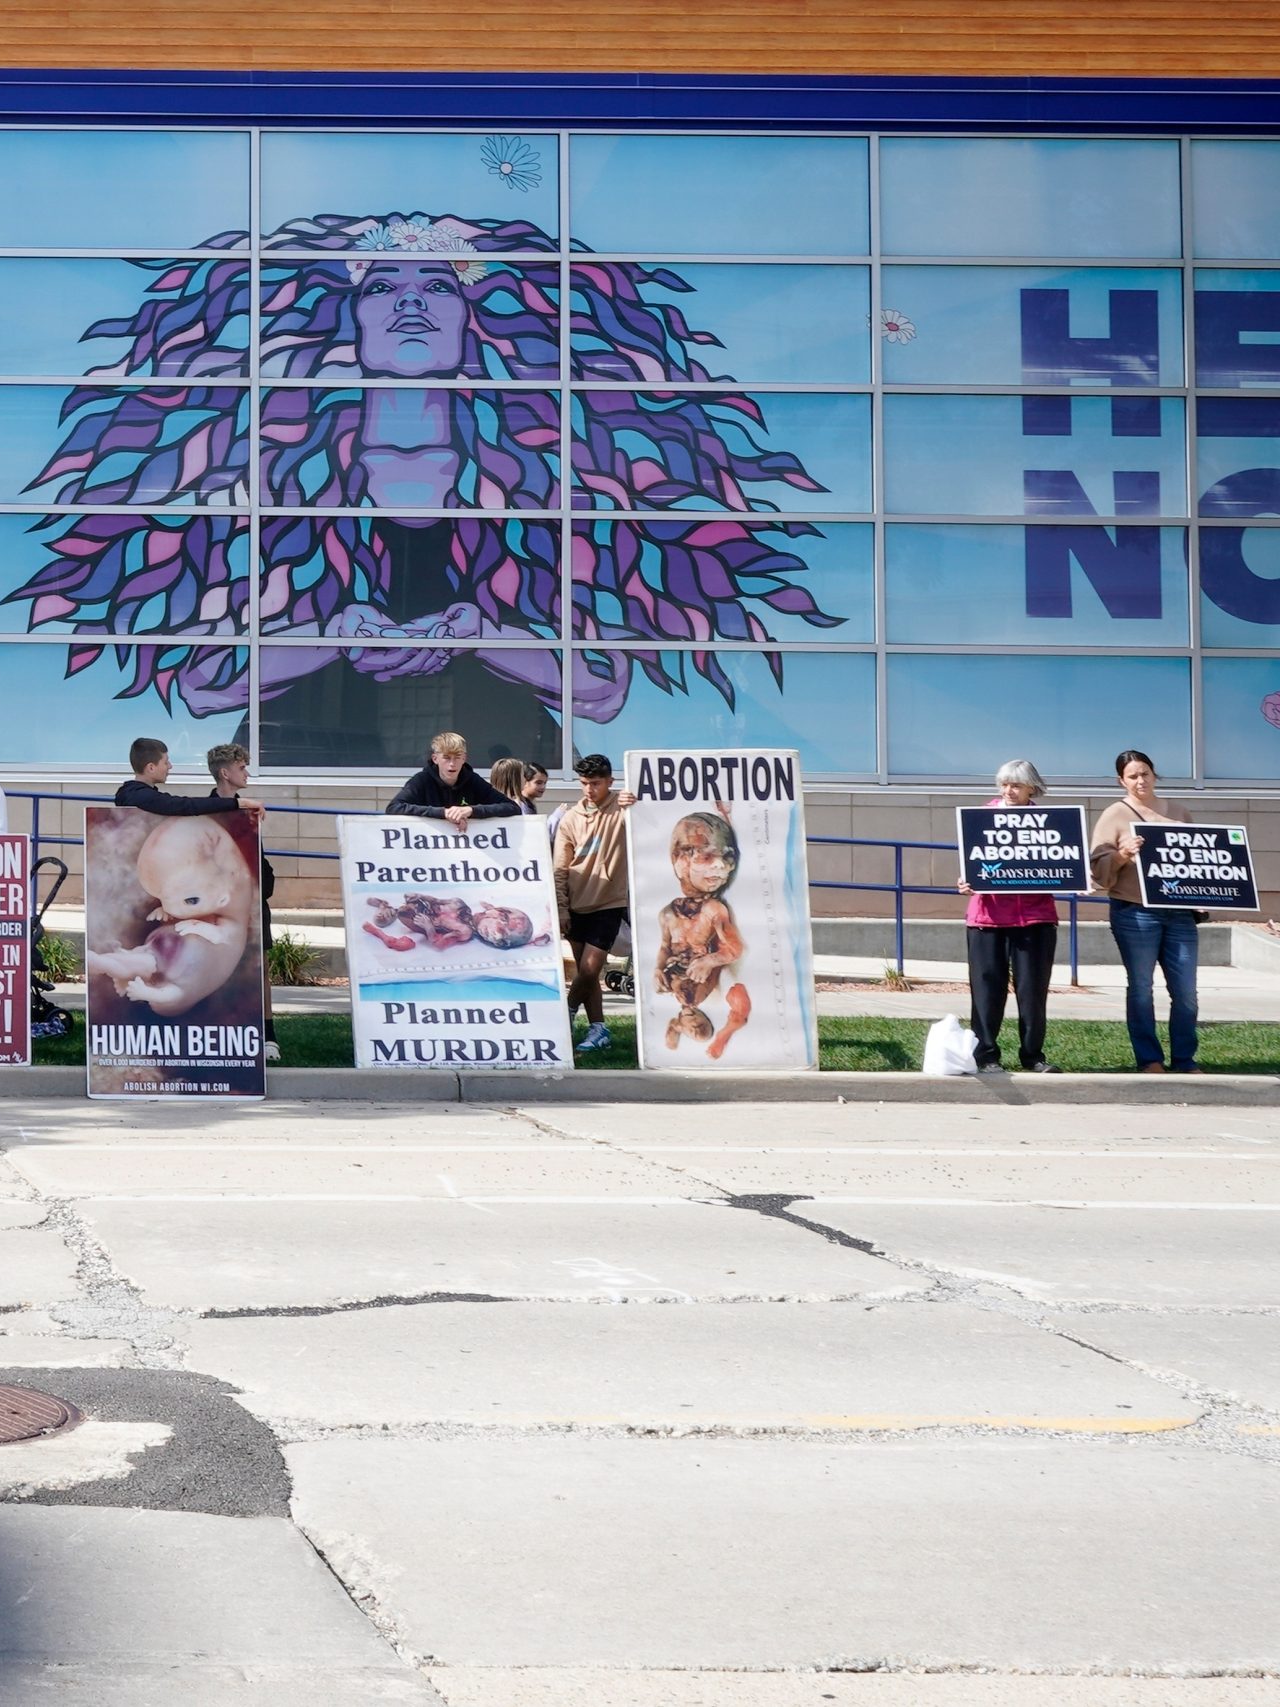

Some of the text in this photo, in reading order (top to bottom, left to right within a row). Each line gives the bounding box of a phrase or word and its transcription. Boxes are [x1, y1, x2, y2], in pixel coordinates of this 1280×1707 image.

[637, 756, 794, 801] ABORTION
[993, 813, 1048, 828] PRAY
[381, 827, 510, 849] Planned
[983, 830, 1061, 845] TO END
[1164, 832, 1217, 848] PRAY
[969, 846, 1080, 860] ABORTION
[1155, 848, 1232, 865] TO END
[355, 860, 542, 883] Parenthood
[1147, 863, 1248, 881] ABORTION
[2, 944, 20, 966] IN
[381, 1002, 530, 1025] Planned
[92, 1025, 260, 1057] HUMAN BEING
[370, 1039, 562, 1062] MURDER
[99, 1058, 113, 1066] OVER
[129, 1059, 157, 1067] MURDERED
[164, 1059, 190, 1067] ABORTION
[190, 1059, 196, 1067] IN
[196, 1059, 224, 1067] WISCONSIN
[124, 1082, 230, 1092] ABOLISH ABORTION WI.COM
